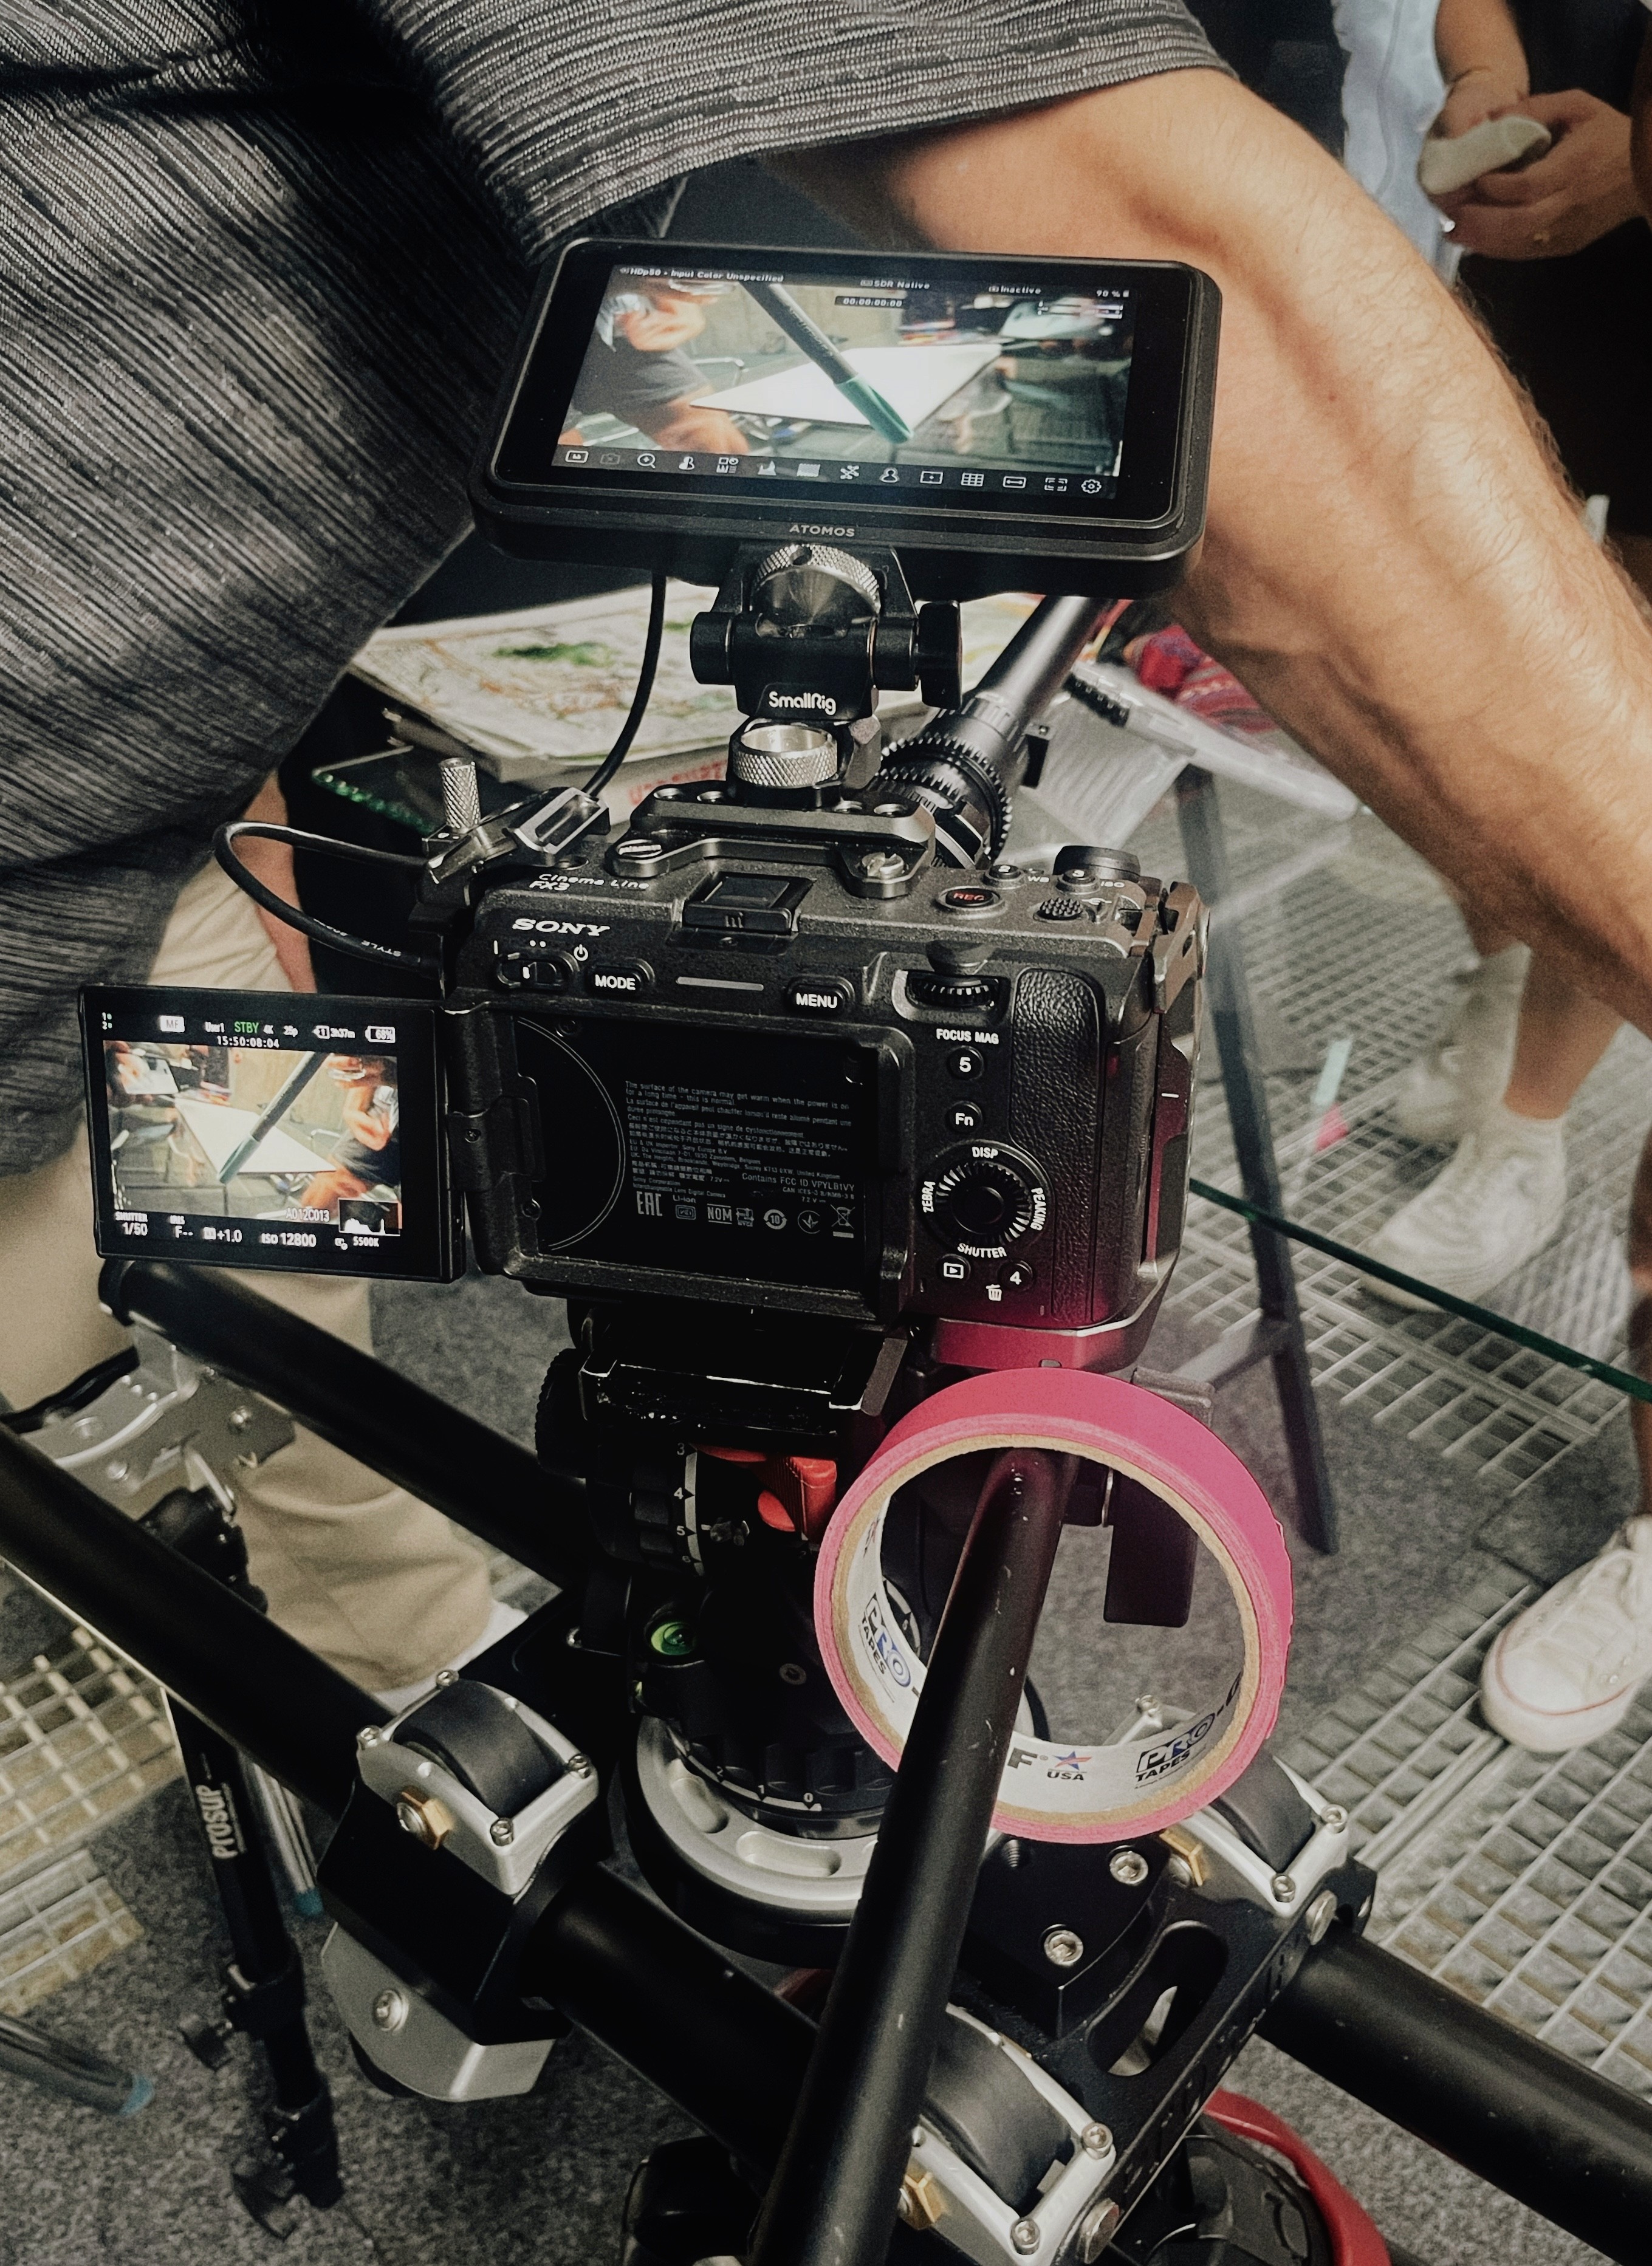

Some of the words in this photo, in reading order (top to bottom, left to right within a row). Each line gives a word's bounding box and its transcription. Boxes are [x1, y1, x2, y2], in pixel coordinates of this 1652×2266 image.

[727, 273, 784, 282] Unspecified
[897, 281, 930, 289] Native
[1001, 286, 1041, 294] Inactive
[790, 524, 855, 537] ATOMOS
[769, 691, 837, 716] SmallRig
[529, 880, 571, 891] FX3
[539, 874, 605, 885] Cinema
[610, 879, 649, 889] Line
[953, 892, 985, 901] REC
[512, 918, 611, 937] SONY
[361, 940, 402, 957] STYLE
[595, 975, 636, 991] MODE
[796, 993, 838, 1009] MENU
[166, 1019, 179, 1029] MF
[235, 1022, 259, 1034] STBY
[217, 1035, 279, 1048] 15:50:08:04
[936, 1029, 972, 1042] FOCUS
[975, 1032, 999, 1044] MAG
[959, 1056, 972, 1073] 5
[640, 1083, 665, 1092] surface
[691, 1089, 717, 1097] camera
[955, 1112, 974, 1126] Fn
[972, 1146, 999, 1159] DISP
[742, 1172, 776, 1183] Contains
[780, 1176, 797, 1186] FCC
[811, 1180, 855, 1192] VPYLB1VY
[921, 1180, 936, 1213] ZEBRA
[636, 1191, 663, 1217] EAC
[1030, 1187, 1047, 1231] PEAKING
[115, 1211, 148, 1222] SHUTTER
[707, 1206, 732, 1222] NOM
[770, 1214, 780, 1224] 10
[123, 1222, 148, 1236] 1/50
[216, 1229, 242, 1243] +1.0
[261, 1233, 279, 1244] ISO
[279, 1232, 317, 1247] 12800
[957, 1242, 1007, 1259] SHUTTER
[1009, 1271, 1022, 1285] 4
[677, 1442, 685, 1456] 3
[674, 1487, 684, 1500] 4
[676, 1525, 685, 1536] 5
[862, 1616, 886, 1675] TAPES
[866, 1592, 911, 1688] PRO
[717, 1765, 724, 1777] 2
[1136, 1751, 1190, 1782] TAPES
[1047, 1771, 1084, 1781] USA
[758, 1784, 764, 1794] 1
[803, 1792, 814, 1803] 0
